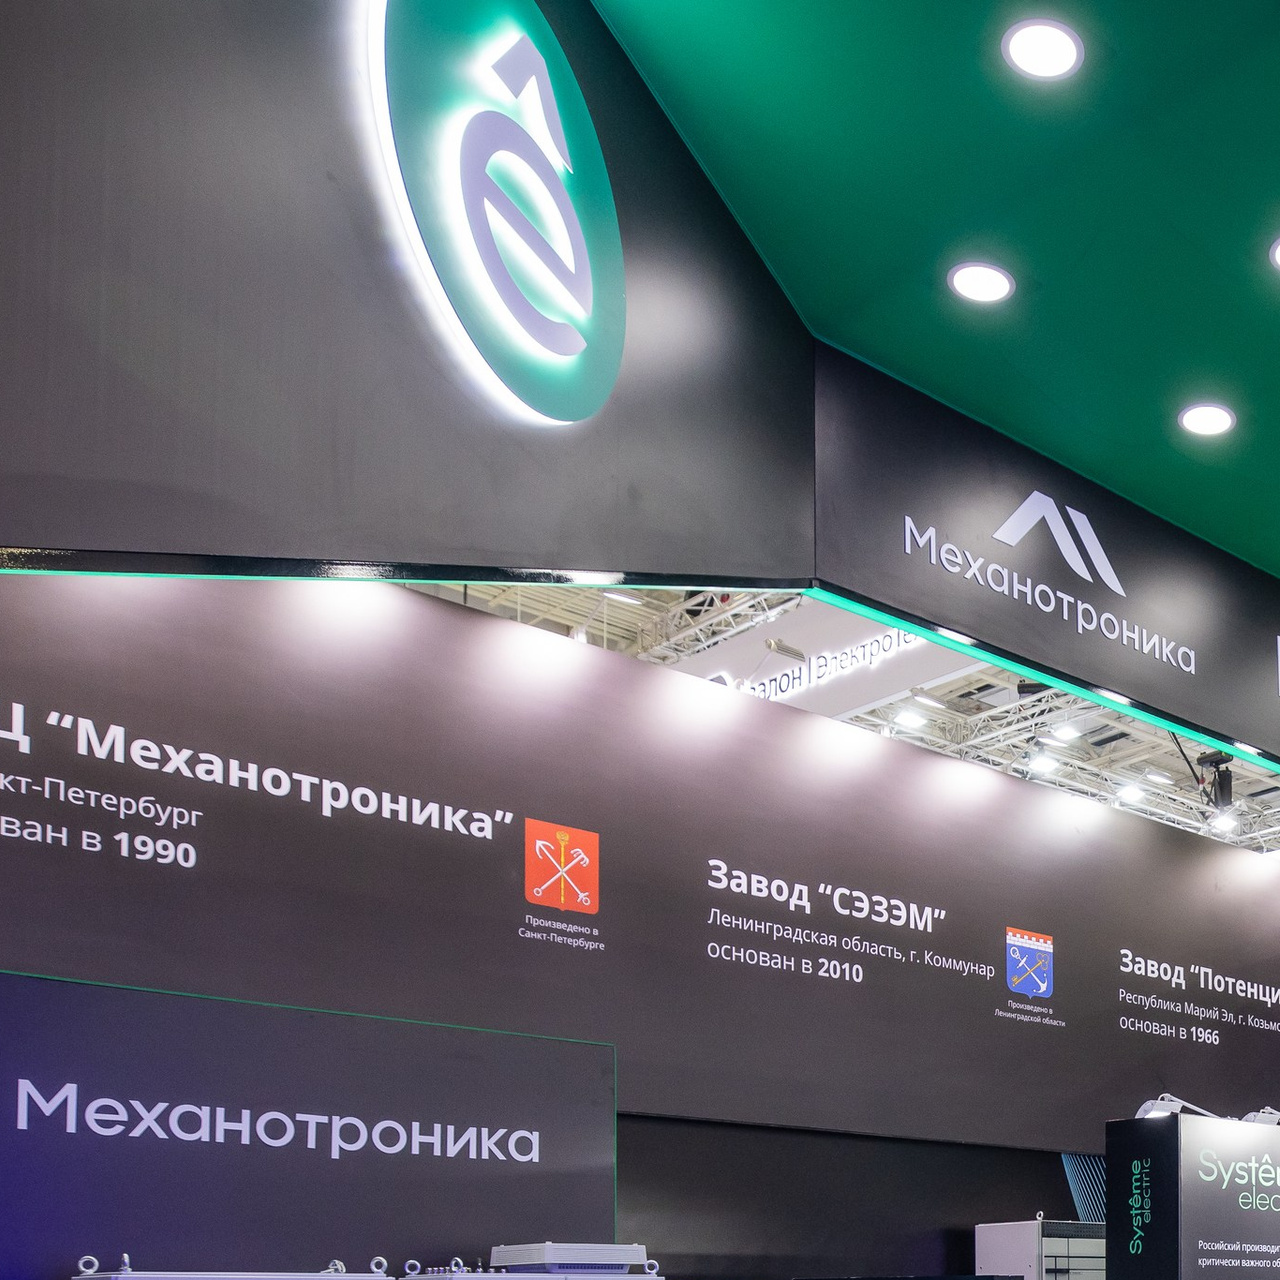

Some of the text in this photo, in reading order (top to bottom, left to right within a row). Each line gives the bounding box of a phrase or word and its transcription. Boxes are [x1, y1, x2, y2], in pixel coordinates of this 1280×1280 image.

[903, 514, 1197, 676] Механотроника
[46, 711, 514, 841] “Механотроника”
[81, 829, 103, 852] в
[113, 831, 197, 869] 1990
[707, 858, 947, 933] Завод “СЭЗЭМ”
[518, 927, 605, 951] Санкт-Петербурге
[525, 914, 599, 936] Произведено в
[707, 907, 996, 980] Ленинградская область, г. Коммунар
[707, 942, 864, 984] основан в 2010
[1119, 948, 1186, 990] Завод
[994, 1008, 1066, 1027] Ленинградской области
[1007, 999, 1048, 1014] Произведено
[1119, 988, 1182, 1013] Республика
[1184, 1001, 1219, 1020] Марий
[1221, 1008, 1236, 1025] Эл,
[1238, 1014, 1246, 1025] г.
[1119, 1016, 1220, 1046] основан в 1966
[16, 1078, 540, 1164] Механотроника
[1128, 1159, 1145, 1255] Systême
[1141, 1157, 1152, 1224] electric
[1198, 1239, 1241, 1251] Российский
[1198, 1257, 1241, 1268] критически
[1241, 1258, 1271, 1268] важного
